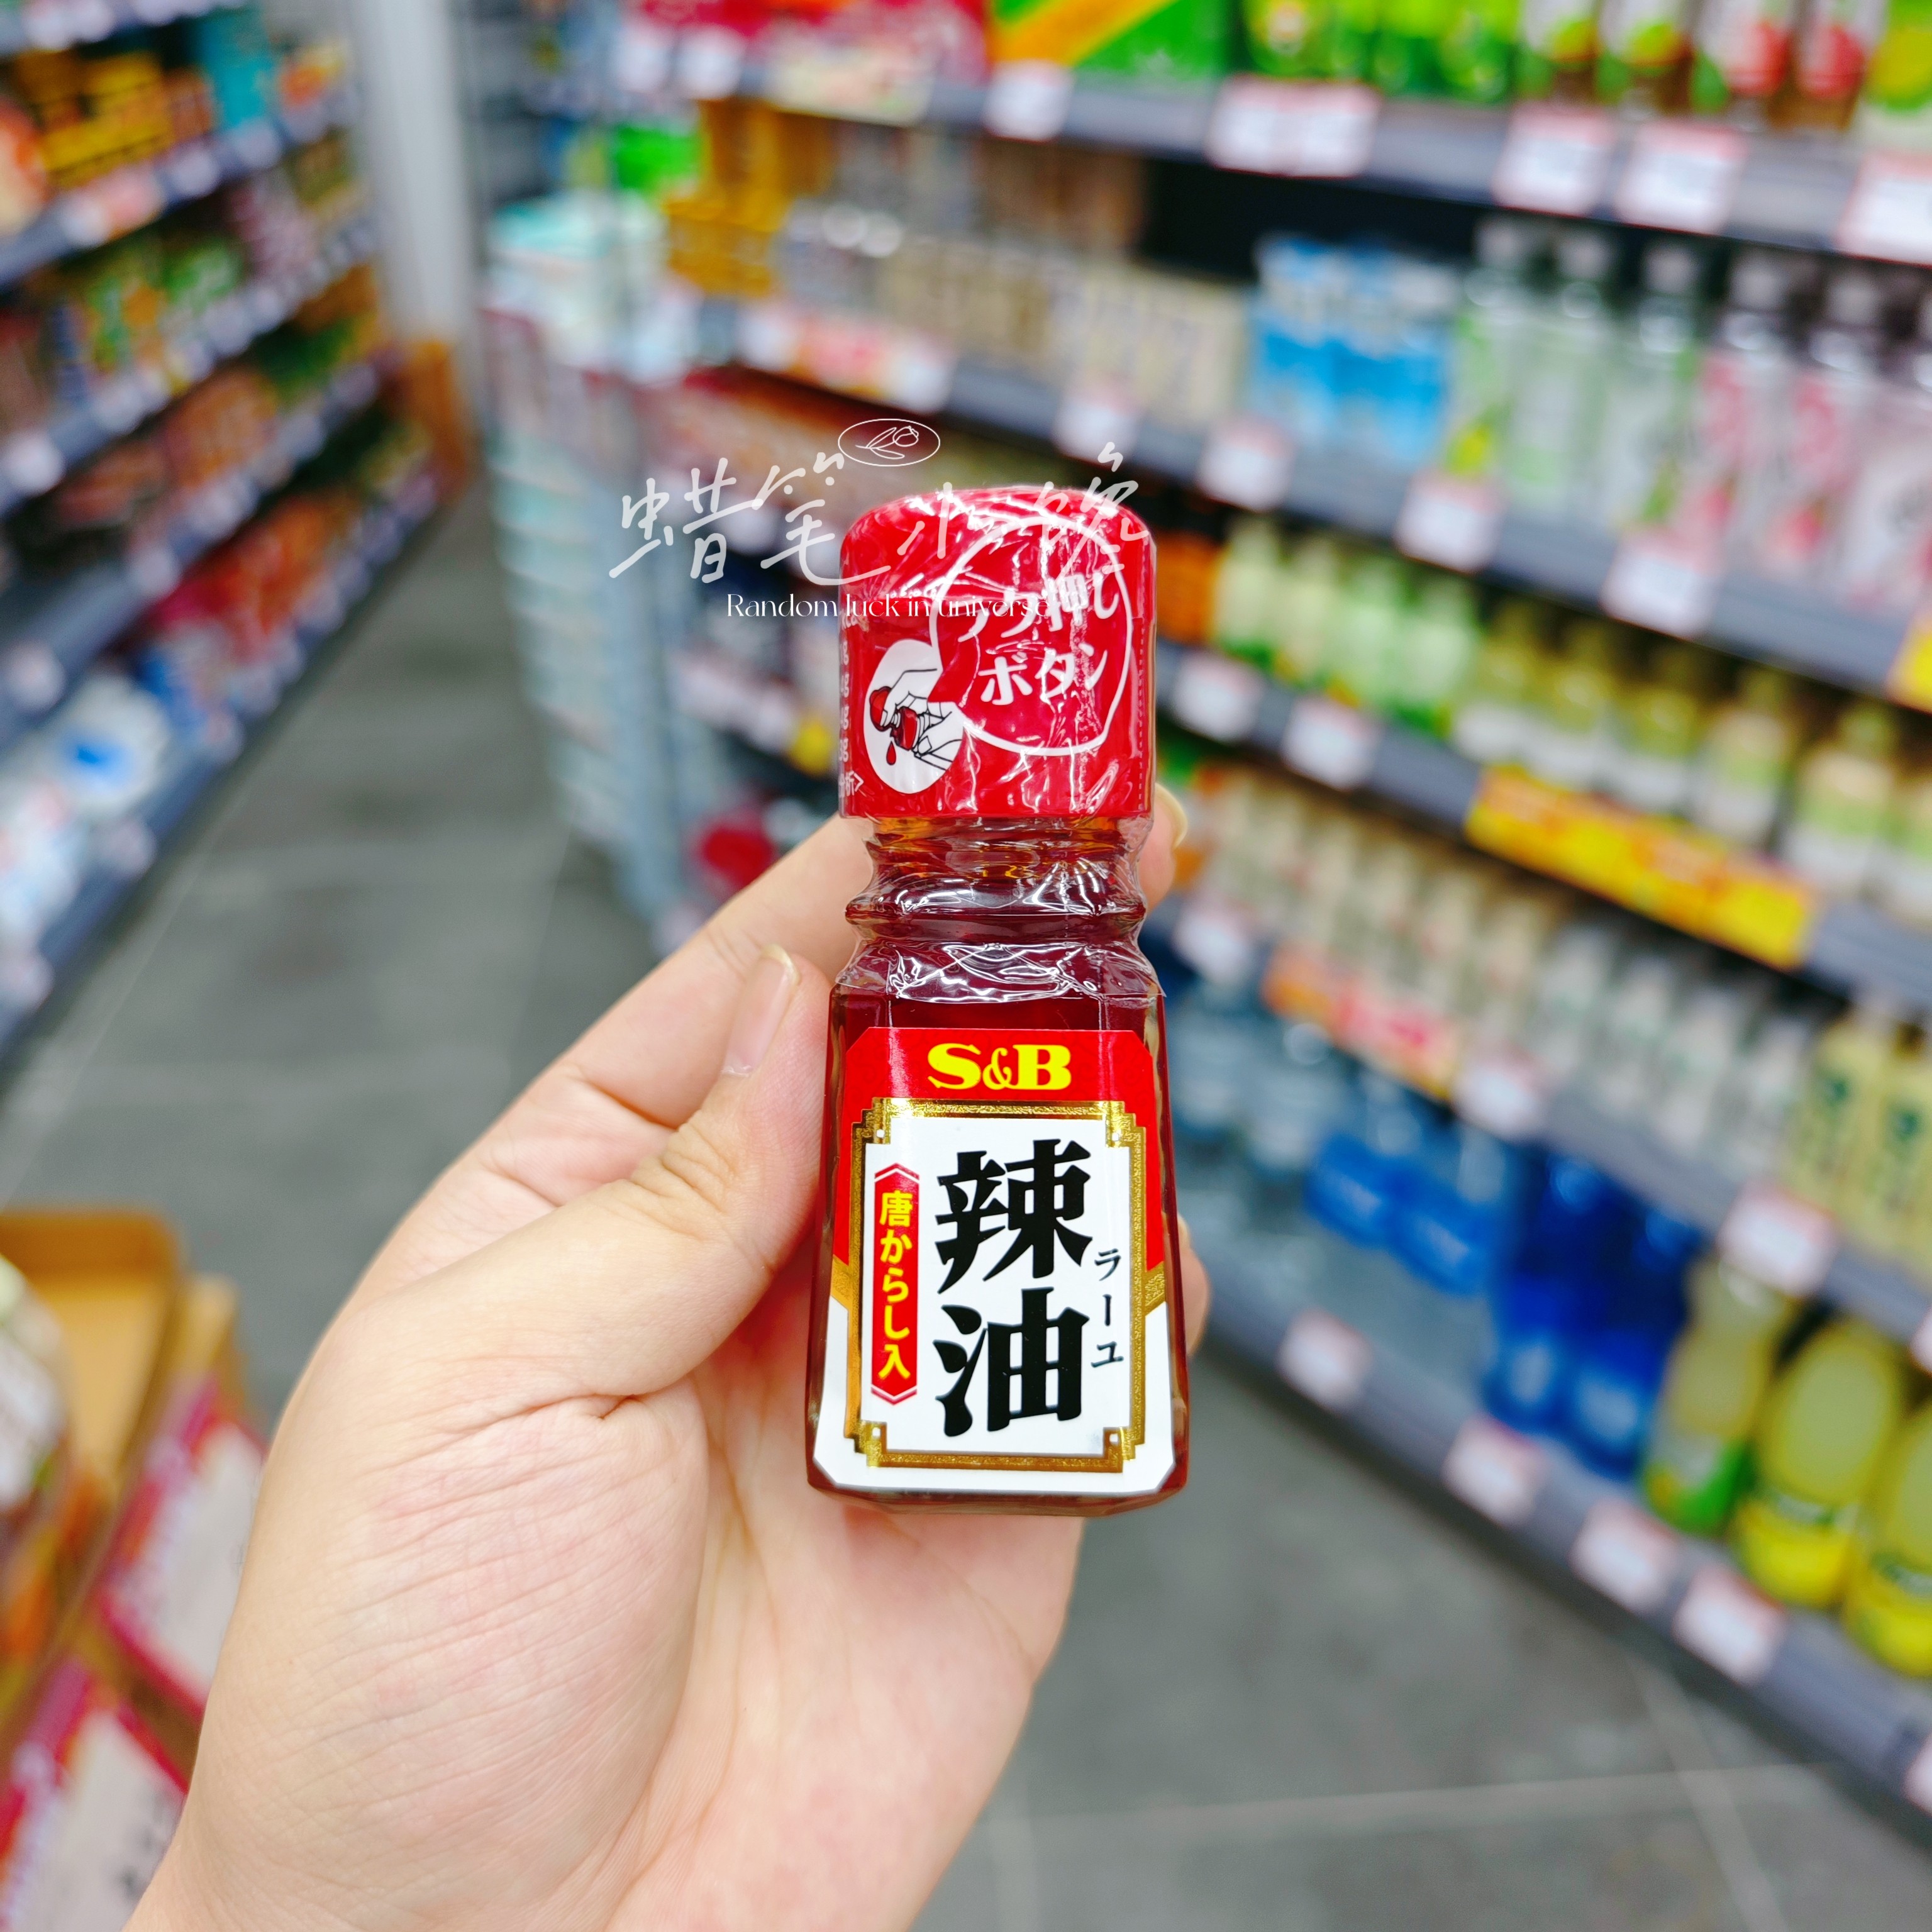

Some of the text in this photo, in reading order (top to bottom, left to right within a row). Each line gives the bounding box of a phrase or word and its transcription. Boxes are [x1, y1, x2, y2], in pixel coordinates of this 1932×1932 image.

[978, 641, 1108, 706] ボタン
[927, 1043, 1072, 1091] S&B
[879, 1189, 913, 1380] 唐からし入
[933, 1139, 1094, 1437] 辣油
[1091, 1248, 1124, 1369] ラーユ
